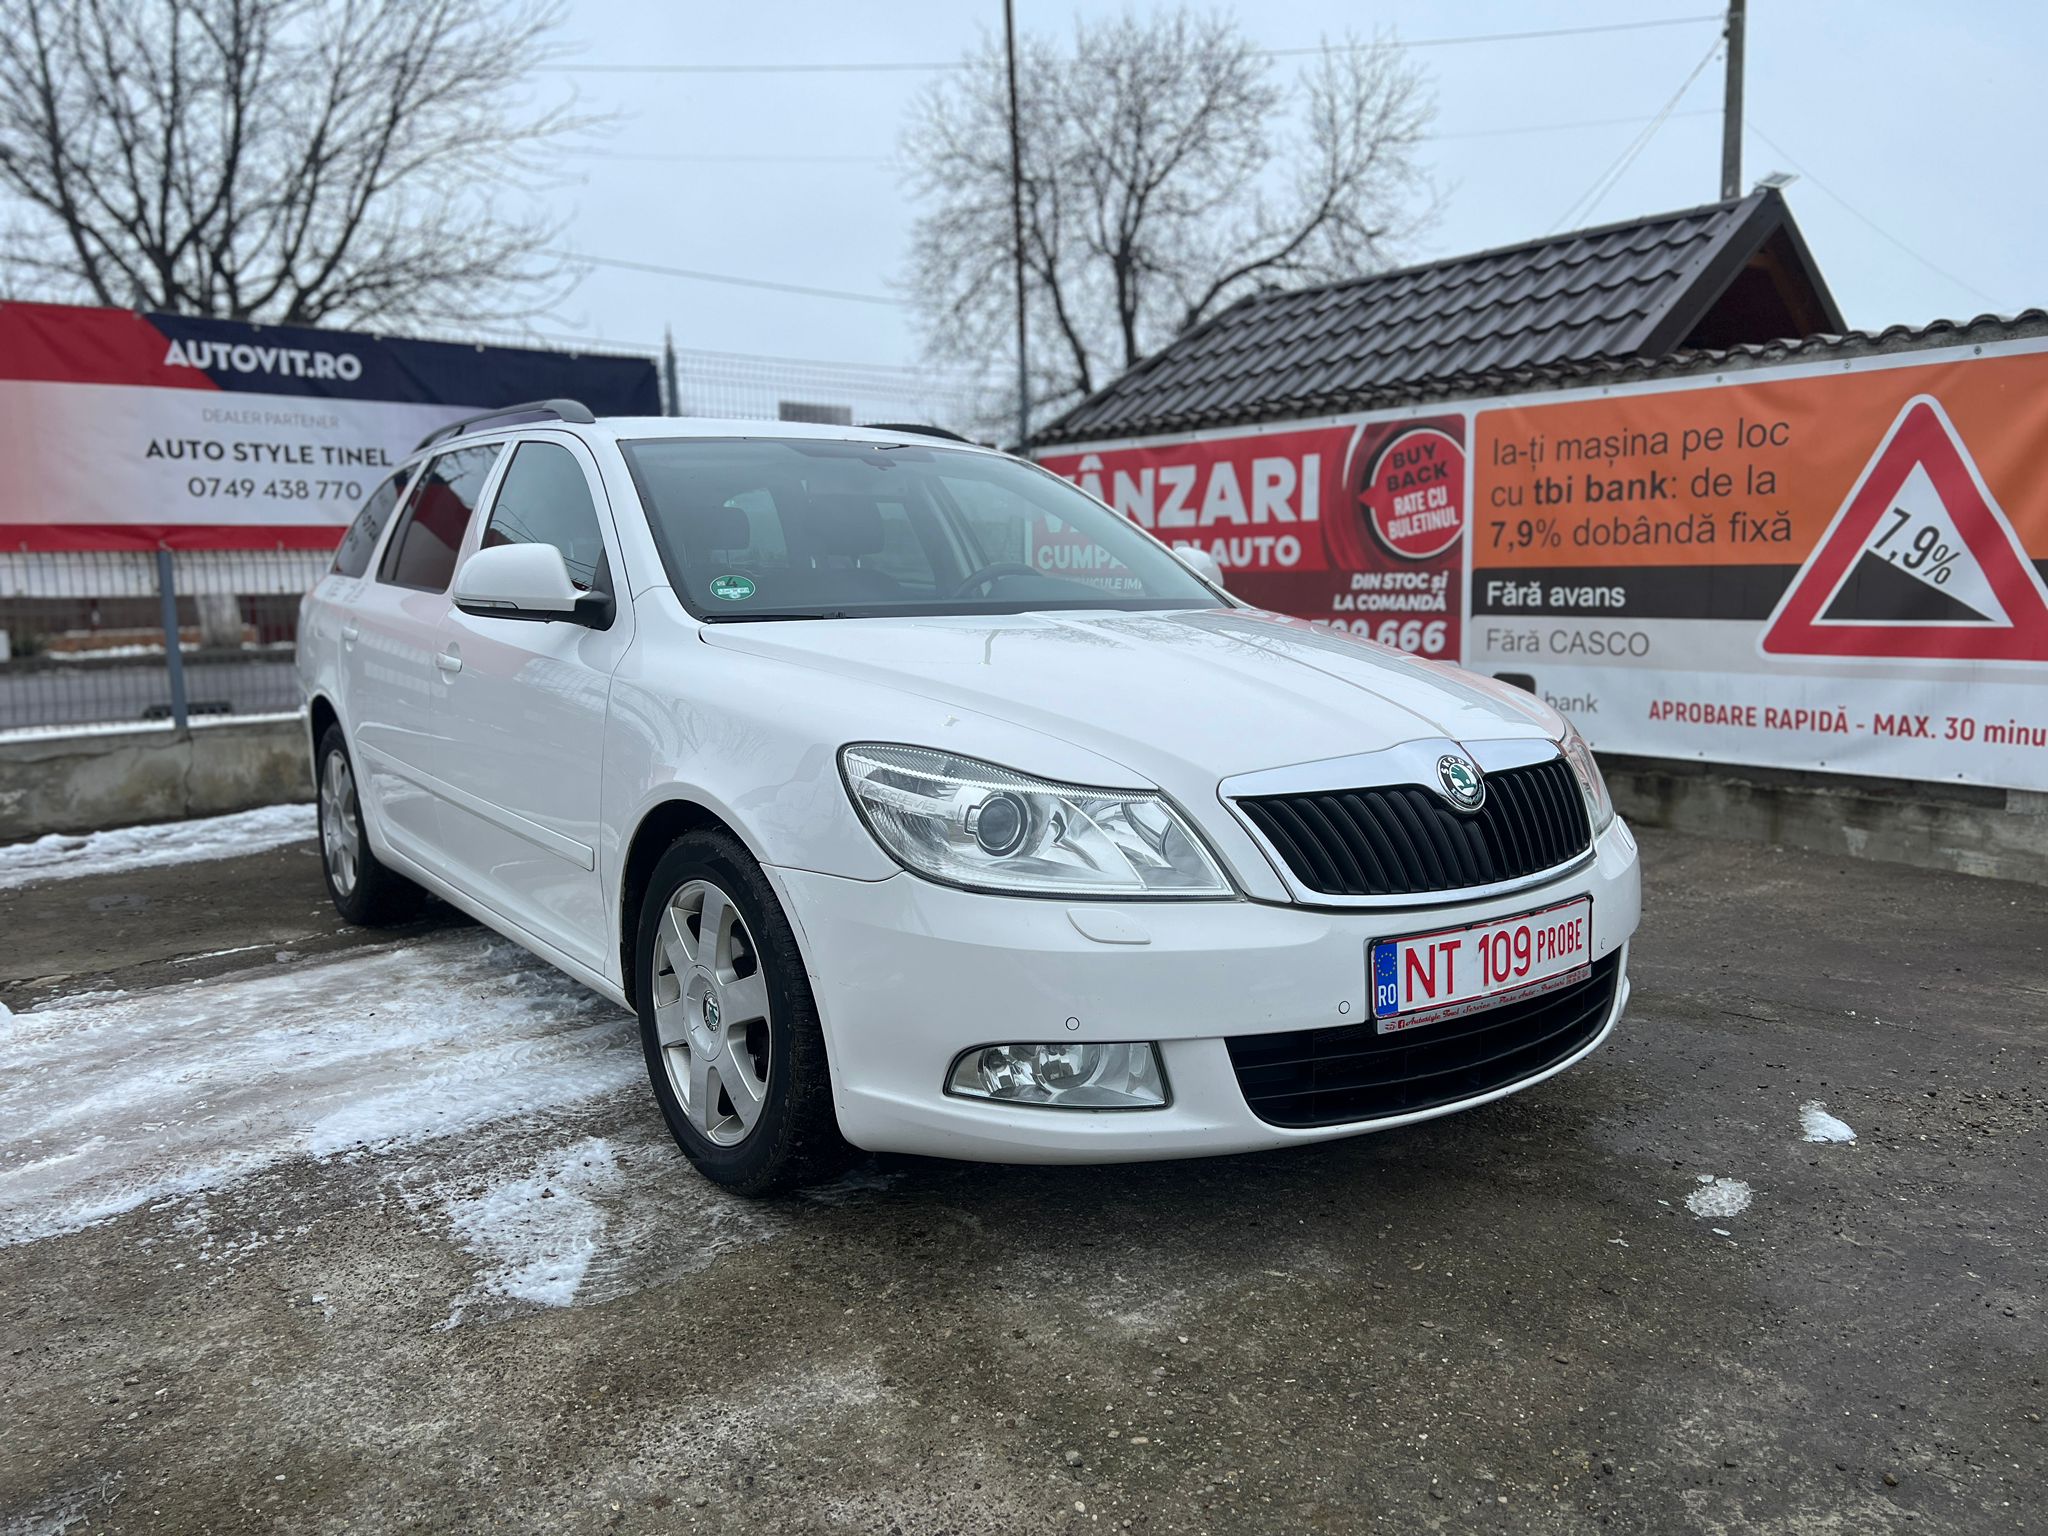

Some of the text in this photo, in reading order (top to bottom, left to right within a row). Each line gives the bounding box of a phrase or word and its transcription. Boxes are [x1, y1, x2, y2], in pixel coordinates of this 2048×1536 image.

[164, 339, 362, 381] AUTOVIT.RO
[202, 408, 339, 429] DEALER PARTENER
[146, 439, 394, 467] AUTO STYLE TINEL
[1392, 441, 1437, 470] BUY
[1555, 427, 1669, 468] mașina
[1682, 426, 1724, 461] pe
[1737, 417, 1790, 449] loc
[188, 477, 362, 501] 0749 438 770
[1387, 461, 1449, 492] BACK
[1491, 464, 1776, 508] cu tbi bank: de la
[1393, 485, 1448, 517] RATE CU
[1387, 505, 1461, 541] BULETINUL
[1490, 509, 1792, 552] 7,9% dobândă fixă
[1209, 535, 1301, 567] AUTO
[1874, 507, 1961, 584] 7,9%
[726, 576, 738, 587] 4
[1351, 573, 1382, 590] DIN
[1382, 572, 1429, 590] STOC
[1486, 580, 1626, 608] Fără avans
[1332, 591, 1447, 611] LA COMANDĂ
[1486, 628, 1650, 657] Fără CASCO
[1545, 691, 1598, 713] bank
[1648, 700, 1757, 728] APROBARE
[1764, 705, 1848, 734] RAPIDĂ
[1874, 713, 1936, 740] MAX.
[1944, 716, 1976, 741] 30
[1984, 720, 2047, 747] minu
[1405, 918, 1583, 1003] NT 109 PROBE
[1377, 983, 1397, 1007] RO
